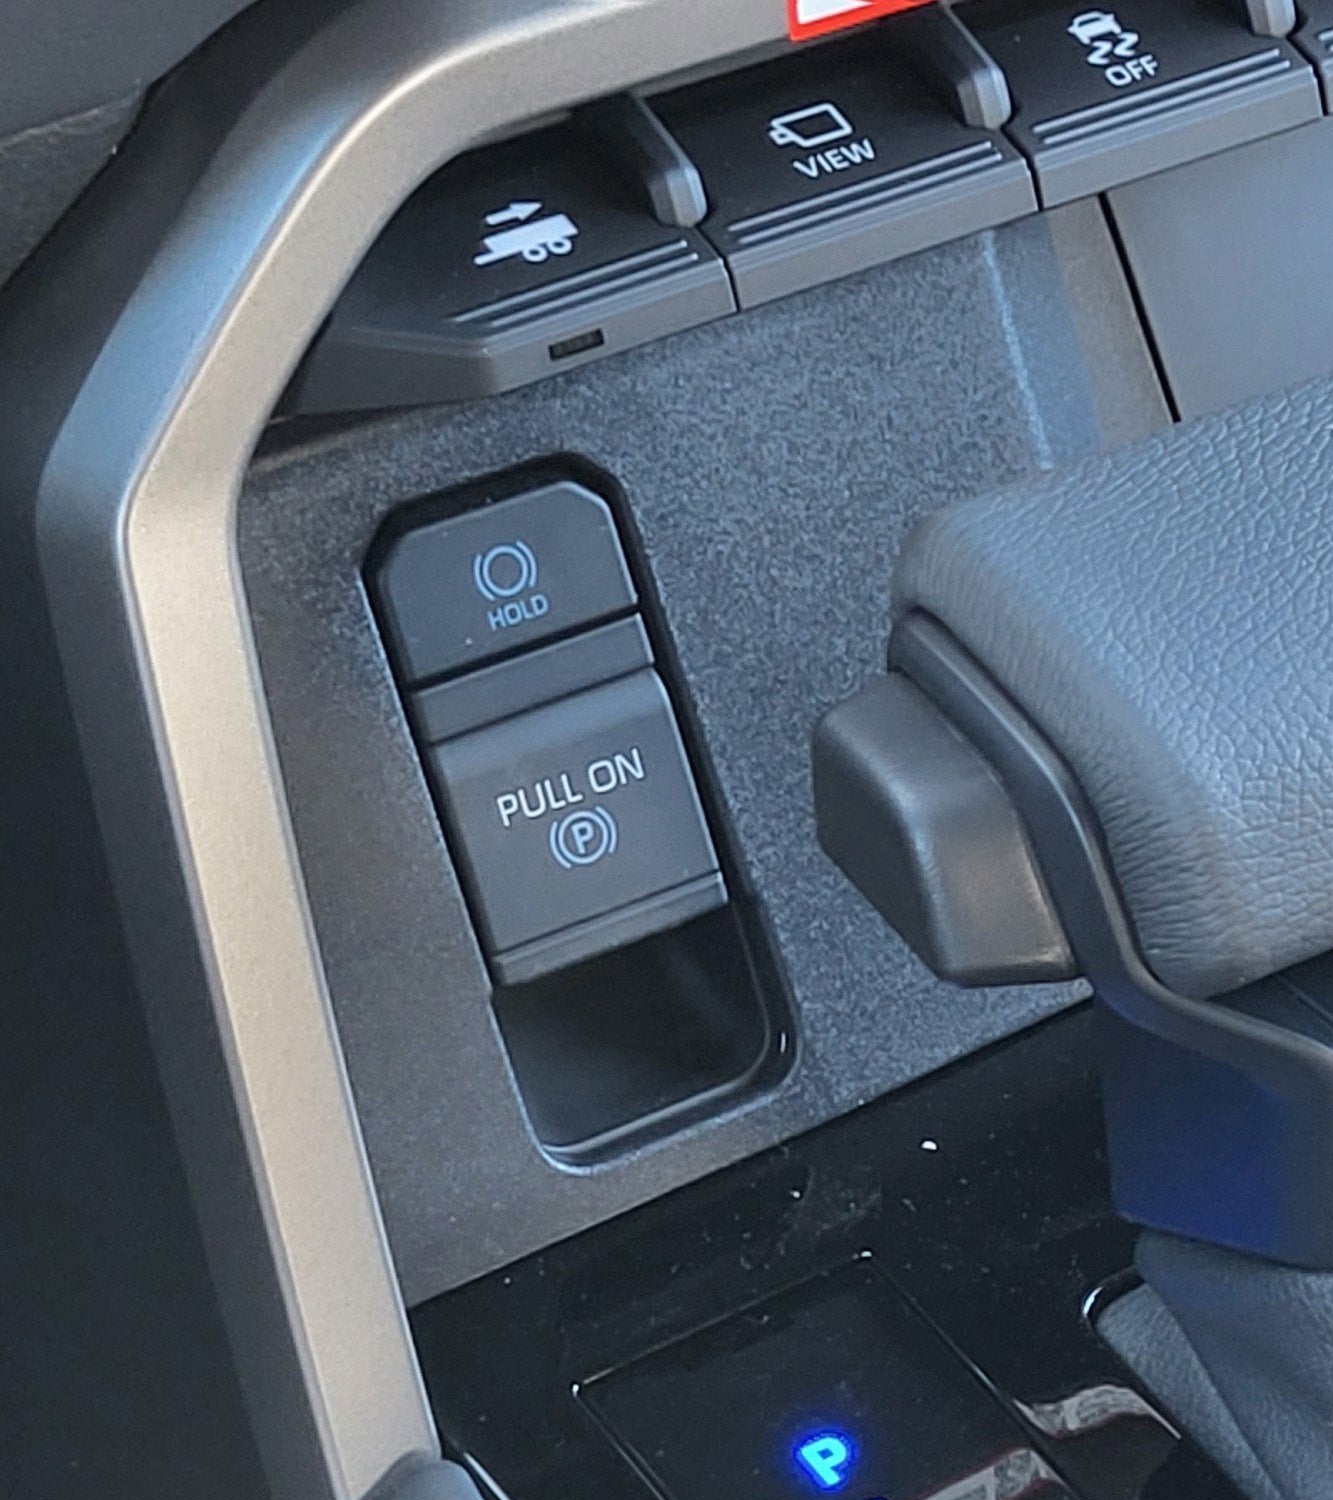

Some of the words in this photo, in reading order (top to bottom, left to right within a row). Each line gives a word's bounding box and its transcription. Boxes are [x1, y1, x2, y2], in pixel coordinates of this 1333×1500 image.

[1105, 55, 1158, 87] OFF
[793, 138, 876, 178] VIEW
[488, 594, 549, 631] HOLD
[496, 773, 583, 827] PULL
[588, 748, 644, 795] ON
[799, 1437, 848, 1486] P
